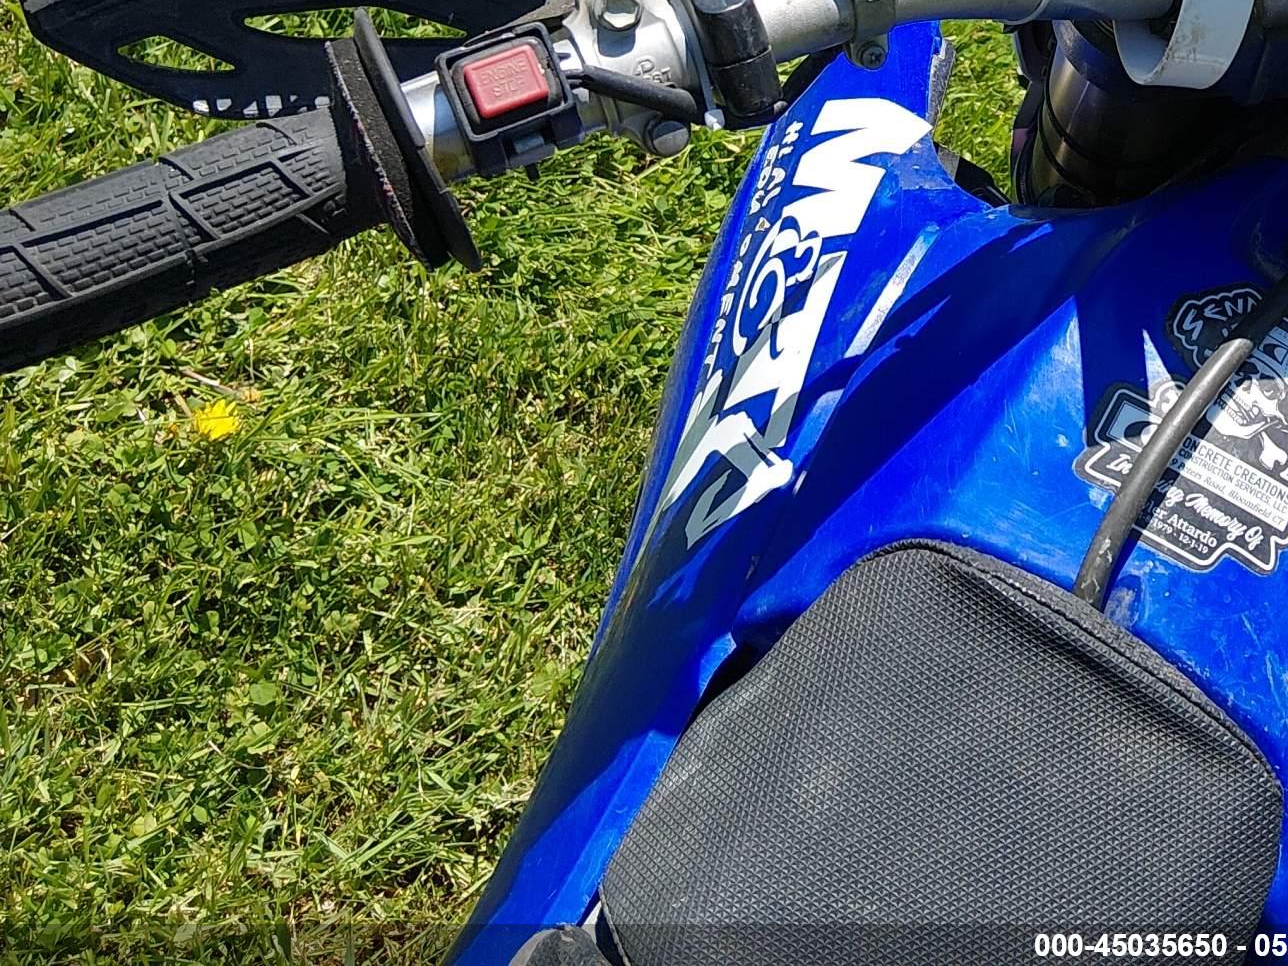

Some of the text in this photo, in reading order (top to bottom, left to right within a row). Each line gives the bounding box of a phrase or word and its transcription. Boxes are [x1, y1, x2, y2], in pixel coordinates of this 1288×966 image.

[480, 58, 529, 85] ENGINE
[1178, 448, 1234, 484] CONSTRUCTION
[1182, 436, 1234, 472] ONCRETE
[1106, 453, 1133, 474] In
[1185, 493, 1247, 541] Memory
[1244, 526, 1265, 551] Of
[1229, 489, 1272, 519] Bloomfield
[1271, 514, 1285, 525] CT
[1145, 500, 1217, 547] ler Attardo
[1178, 532, 1209, 555] 12-1-19
